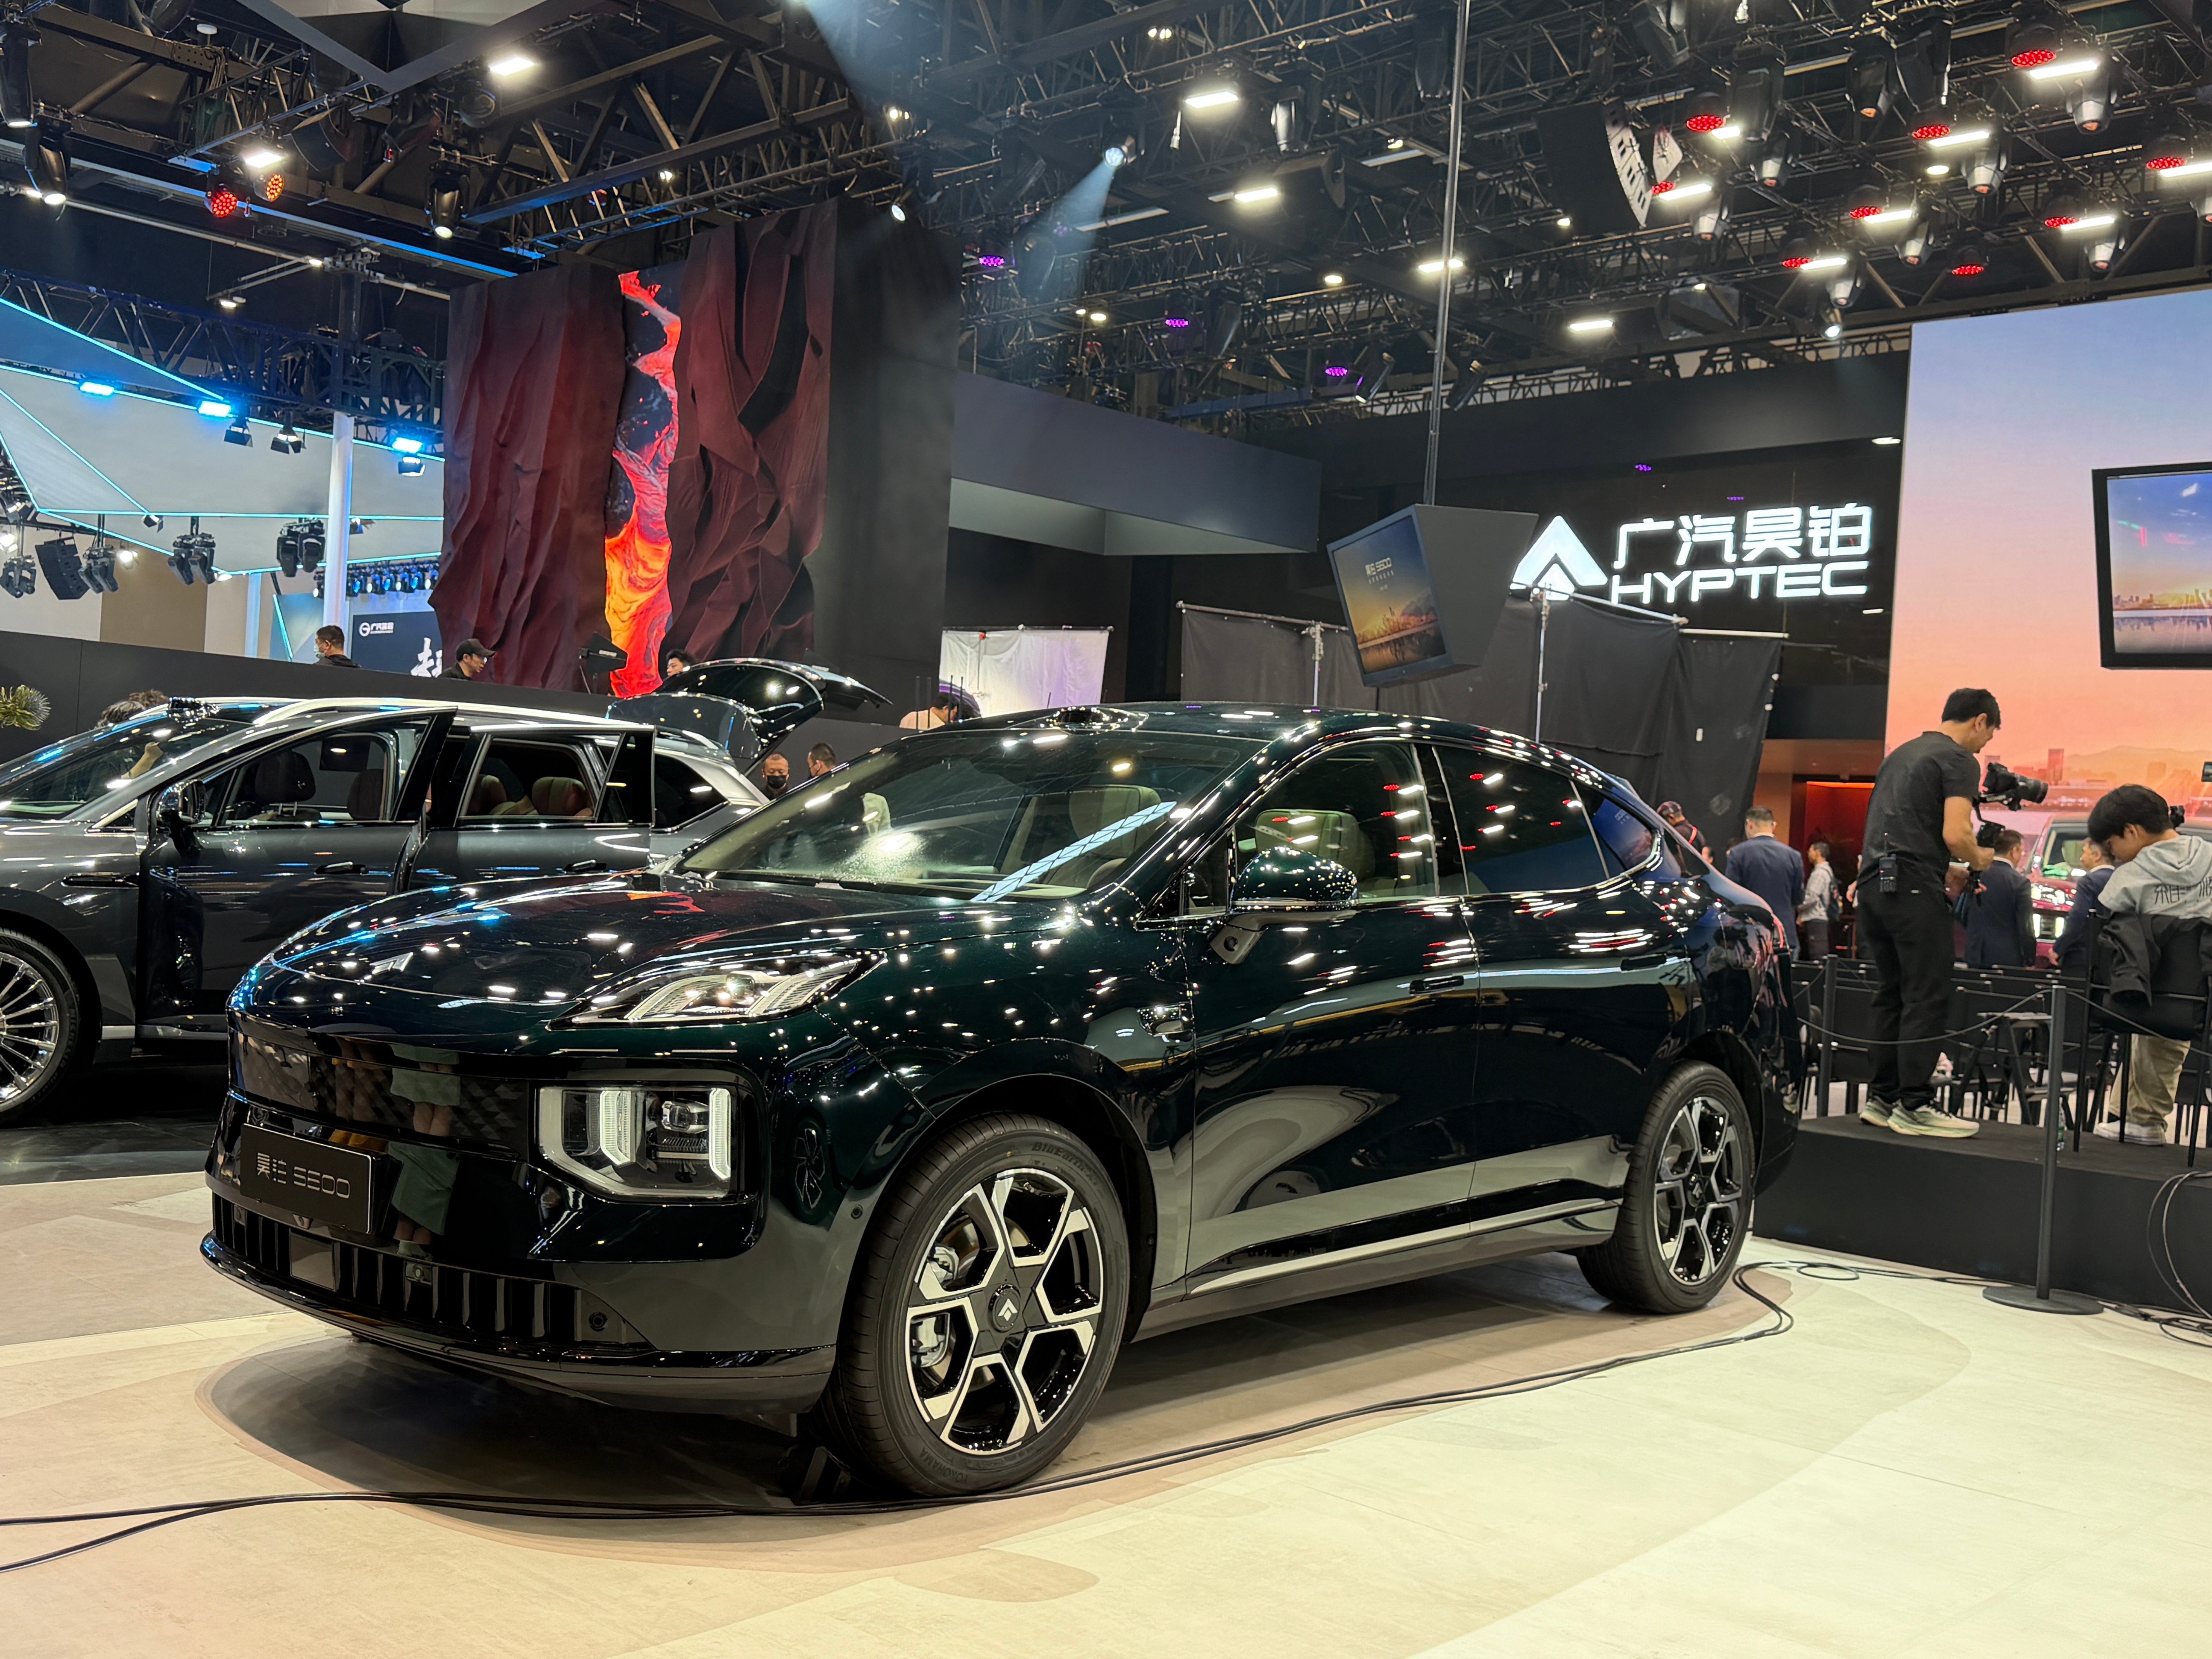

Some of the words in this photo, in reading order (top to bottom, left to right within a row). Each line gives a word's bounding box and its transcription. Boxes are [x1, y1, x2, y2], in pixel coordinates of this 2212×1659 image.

[1613, 503, 1872, 569] 广汽昊铂
[1611, 560, 1870, 605] HYPTEC
[257, 1152, 287, 1184] 昊铂
[919, 1447, 968, 1484] YOKOHAMA
